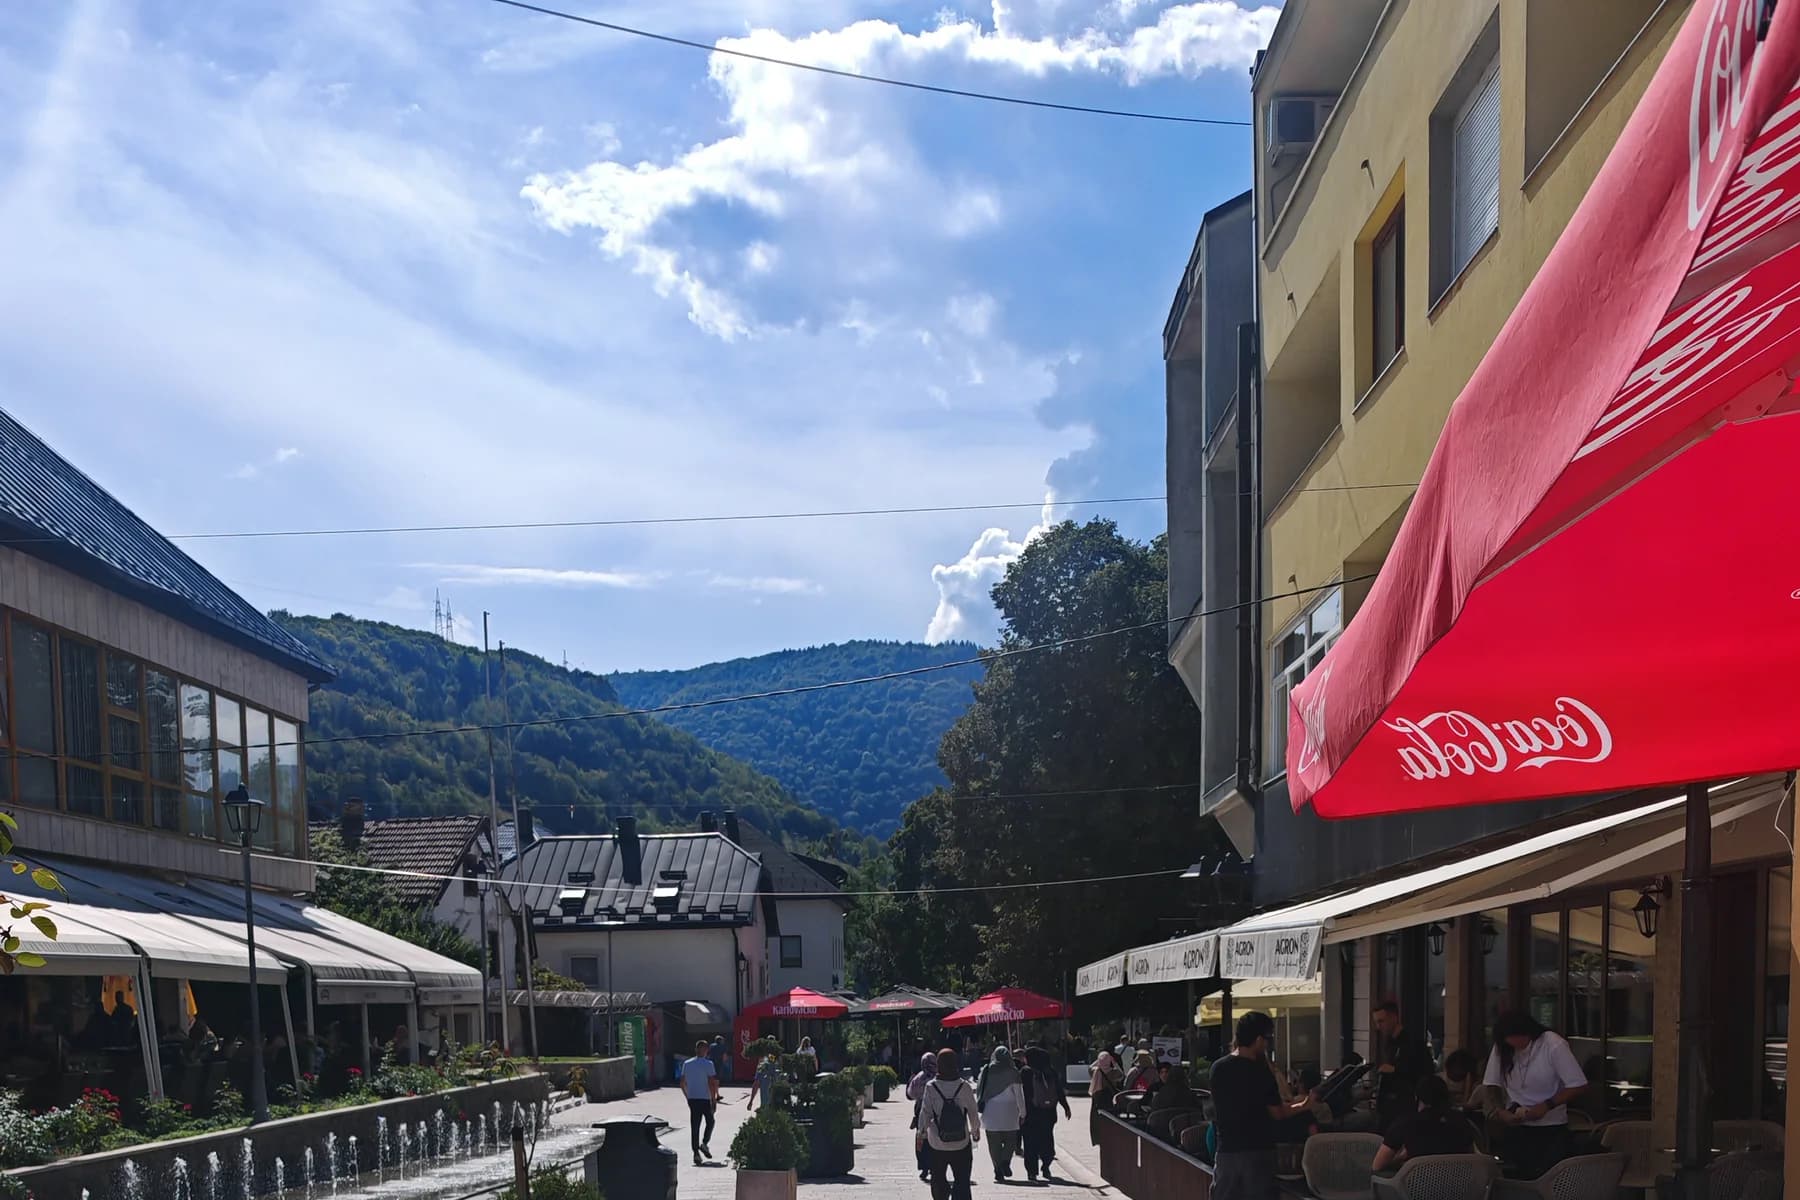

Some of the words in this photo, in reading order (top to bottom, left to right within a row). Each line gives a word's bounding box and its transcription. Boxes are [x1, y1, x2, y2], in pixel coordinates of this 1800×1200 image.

[1235, 941, 1254, 956] AGRON
[1274, 938, 1299, 955] AGRON
[1183, 949, 1204, 969] AGRON
